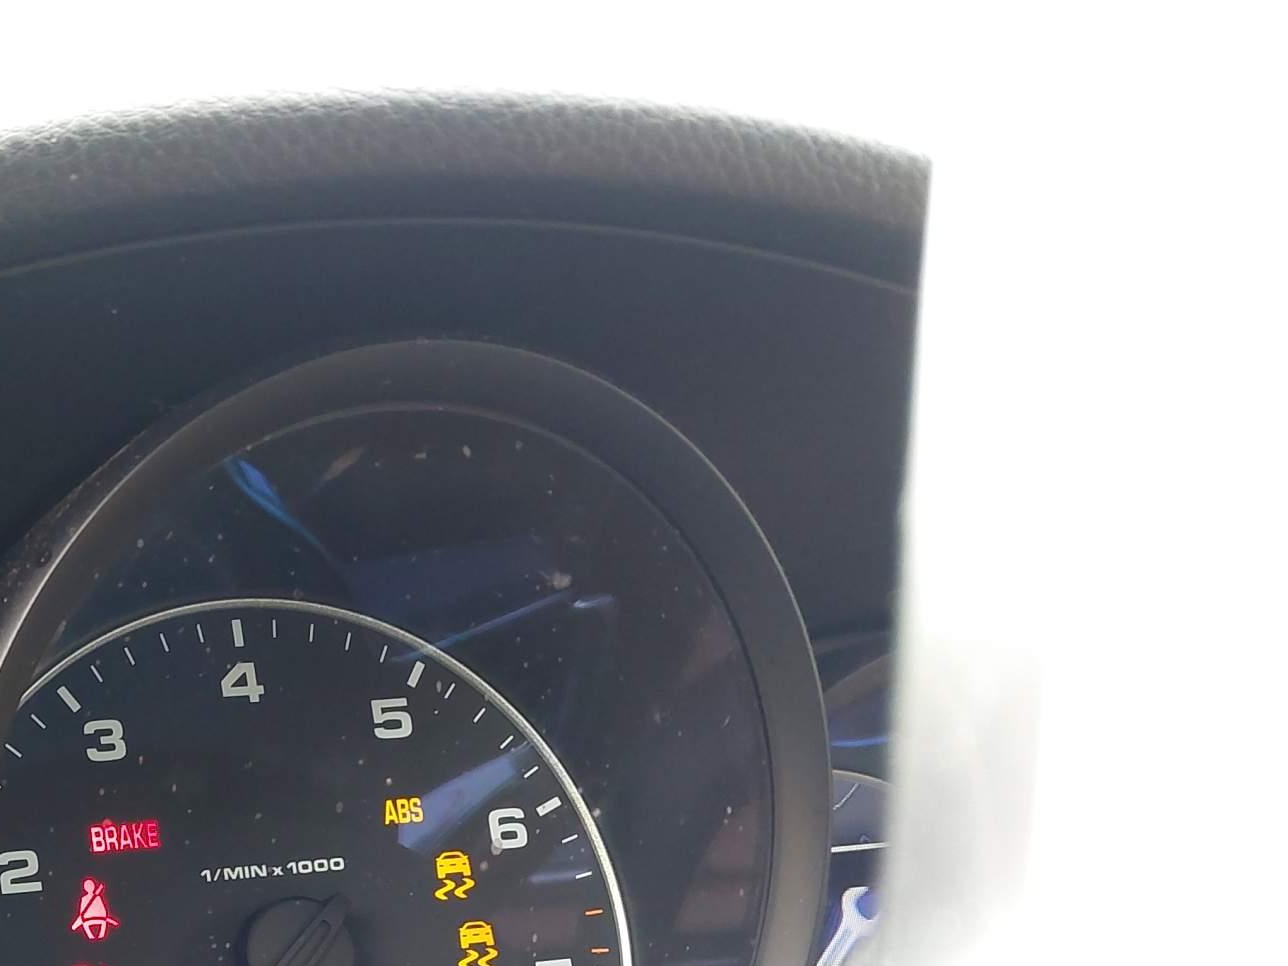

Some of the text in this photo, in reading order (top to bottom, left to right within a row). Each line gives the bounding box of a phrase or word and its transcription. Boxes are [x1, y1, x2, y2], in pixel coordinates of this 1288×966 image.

[221, 662, 265, 703] 4
[371, 698, 413, 739] 5
[84, 719, 126, 761] 3
[384, 798, 424, 825] ABS
[488, 808, 529, 849] 6
[91, 822, 161, 853] BRAKE
[200, 864, 268, 883] 1/MIN
[286, 857, 346, 875] 1000
